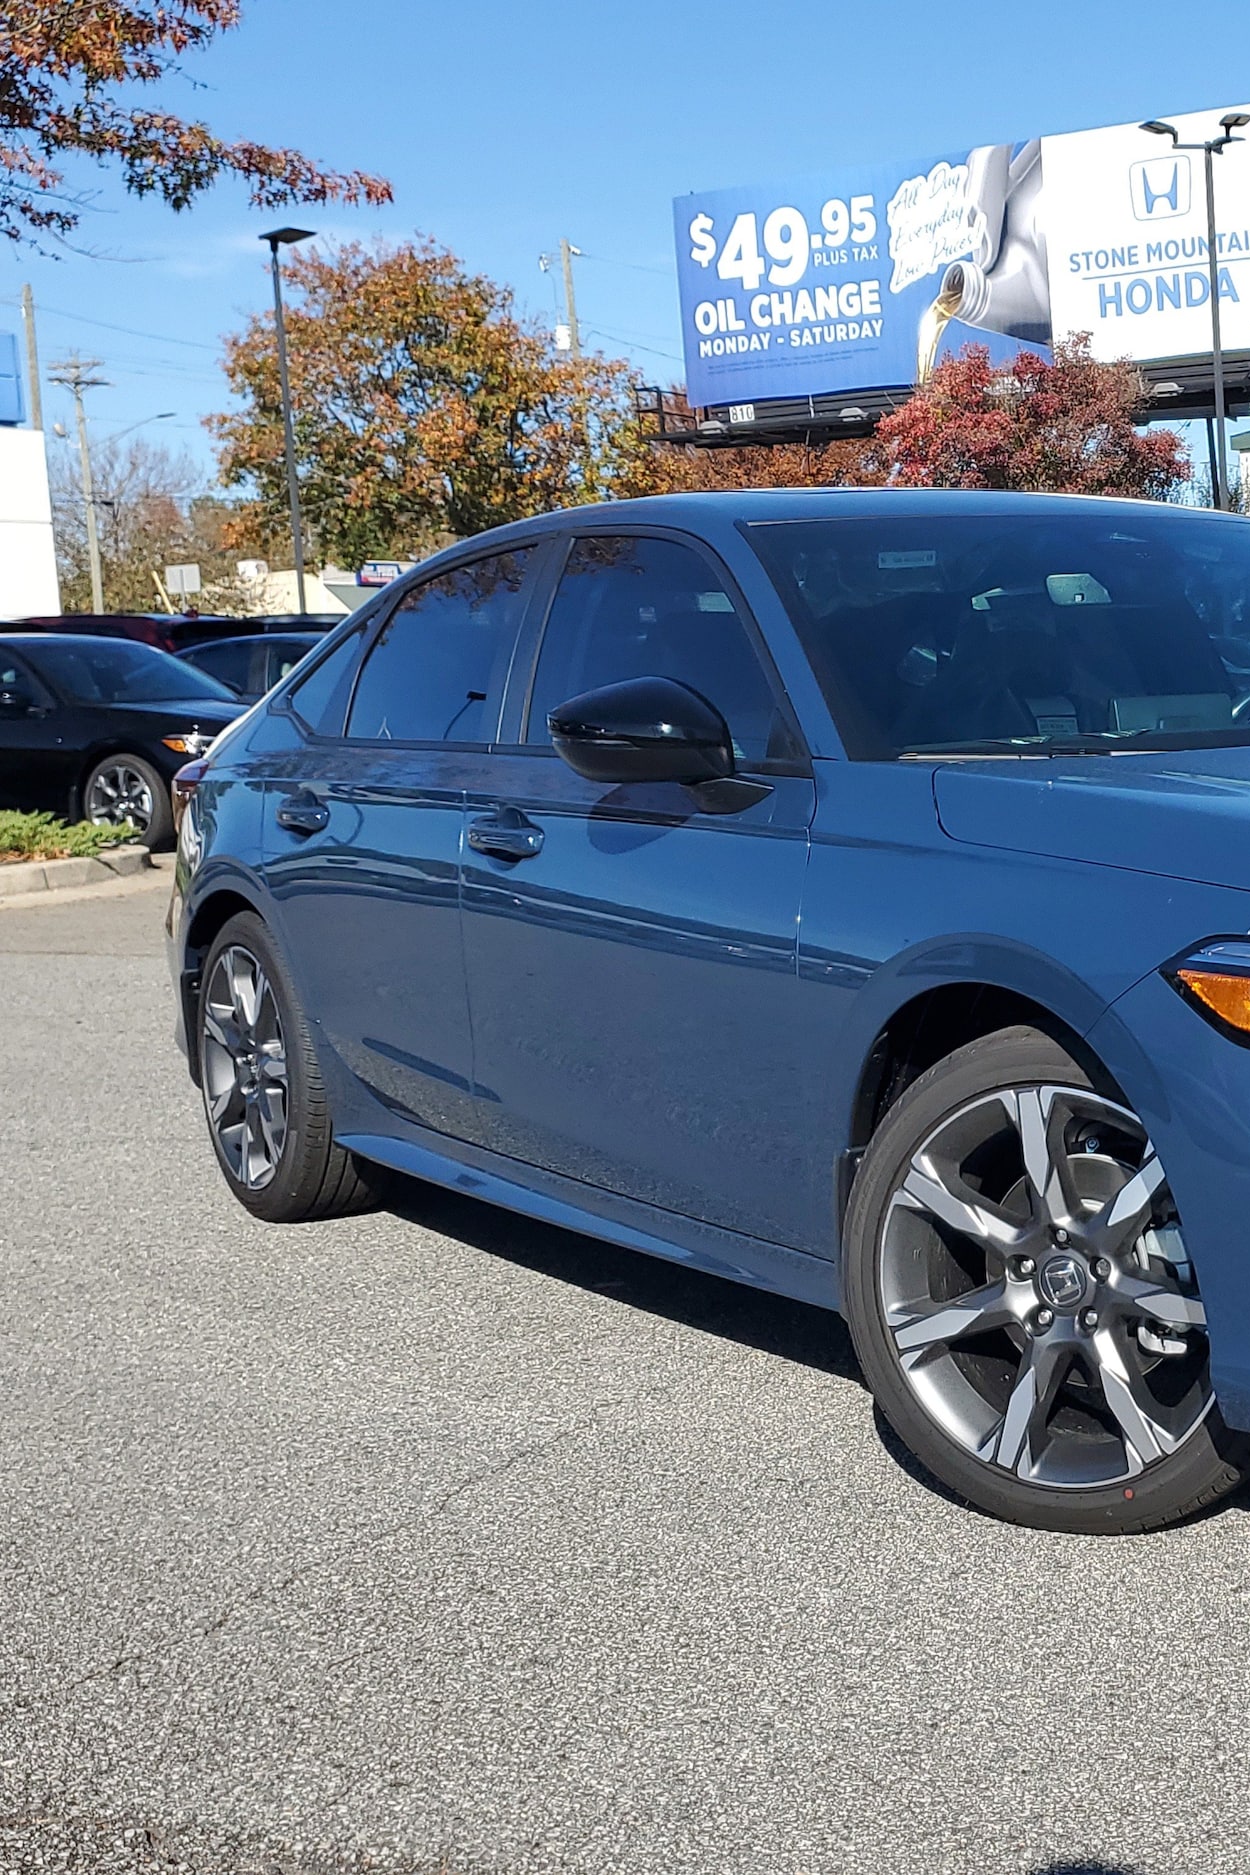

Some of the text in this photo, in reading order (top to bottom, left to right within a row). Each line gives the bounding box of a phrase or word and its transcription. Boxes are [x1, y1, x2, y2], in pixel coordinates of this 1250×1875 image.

[892, 168, 960, 219] All Day
[895, 201, 963, 252] Everyday
[813, 245, 879, 267] PLUS TAX
[1069, 245, 1139, 273] STONE
[694, 279, 882, 336] OIL CHANGE
[1098, 267, 1240, 318] HONDA
[698, 332, 771, 359] MONDAY
[789, 319, 884, 347] SATURDAY
[731, 406, 753, 421] 810
